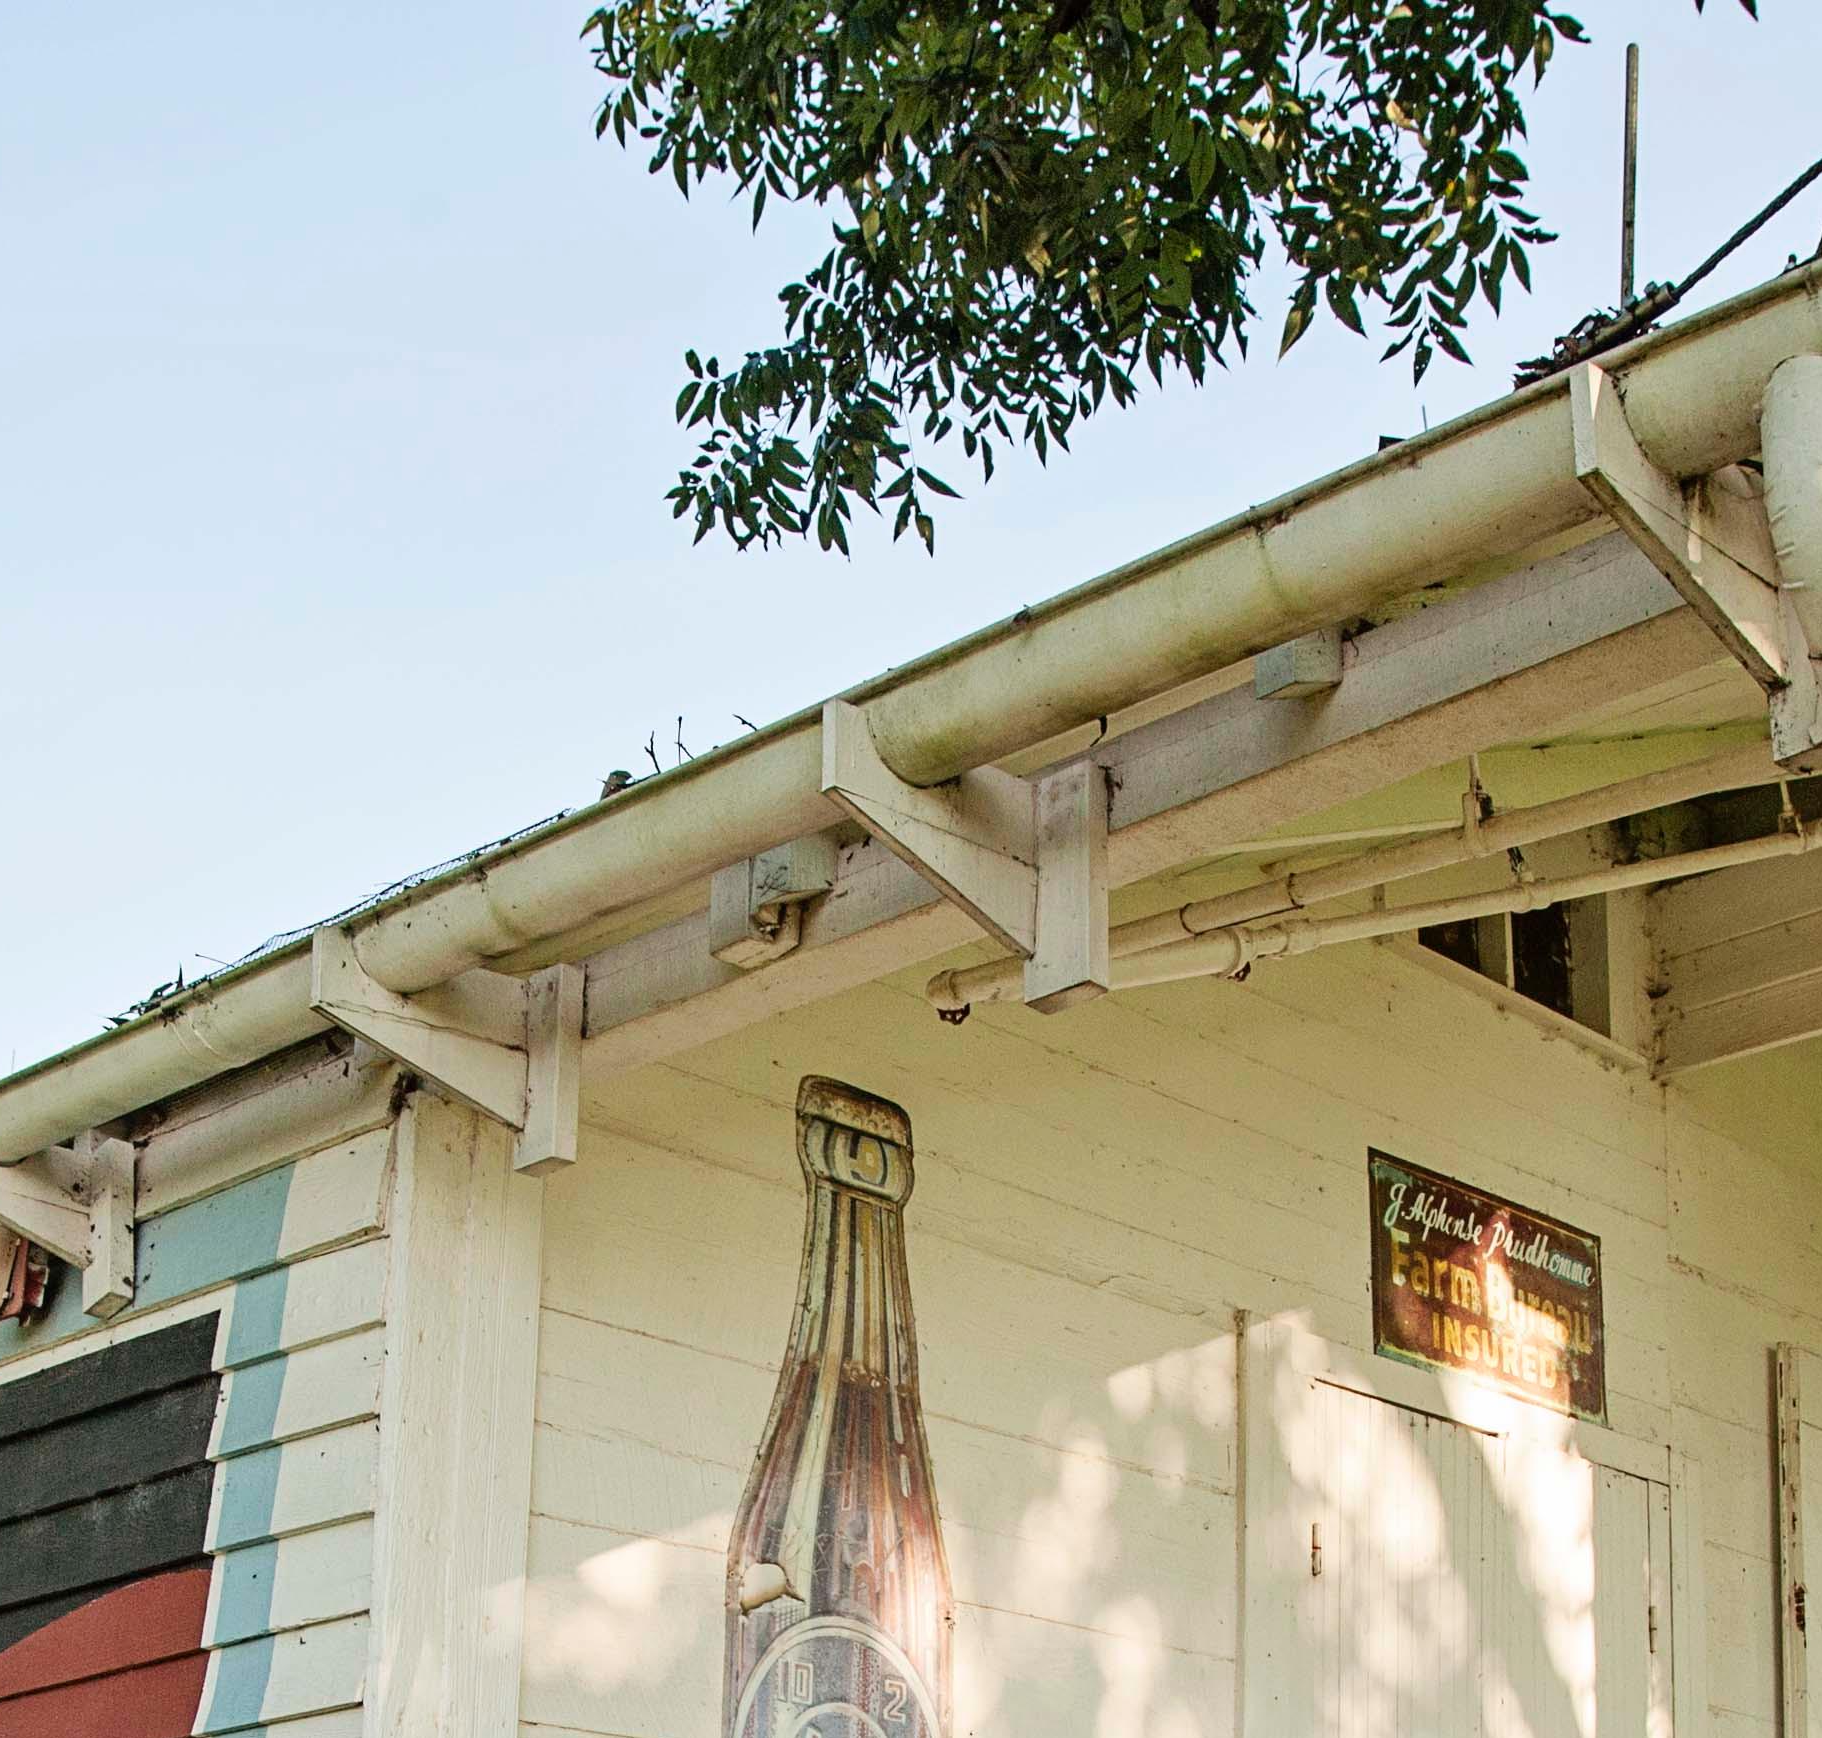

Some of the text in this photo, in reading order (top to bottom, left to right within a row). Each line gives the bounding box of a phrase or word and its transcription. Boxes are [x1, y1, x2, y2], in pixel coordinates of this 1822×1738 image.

[1481, 1221, 1596, 1288] Prudhomme
[1390, 1227, 1594, 1355] Farm Bureau
[1432, 1311, 1558, 1389] INSURED
[882, 1677, 908, 1725] 2
